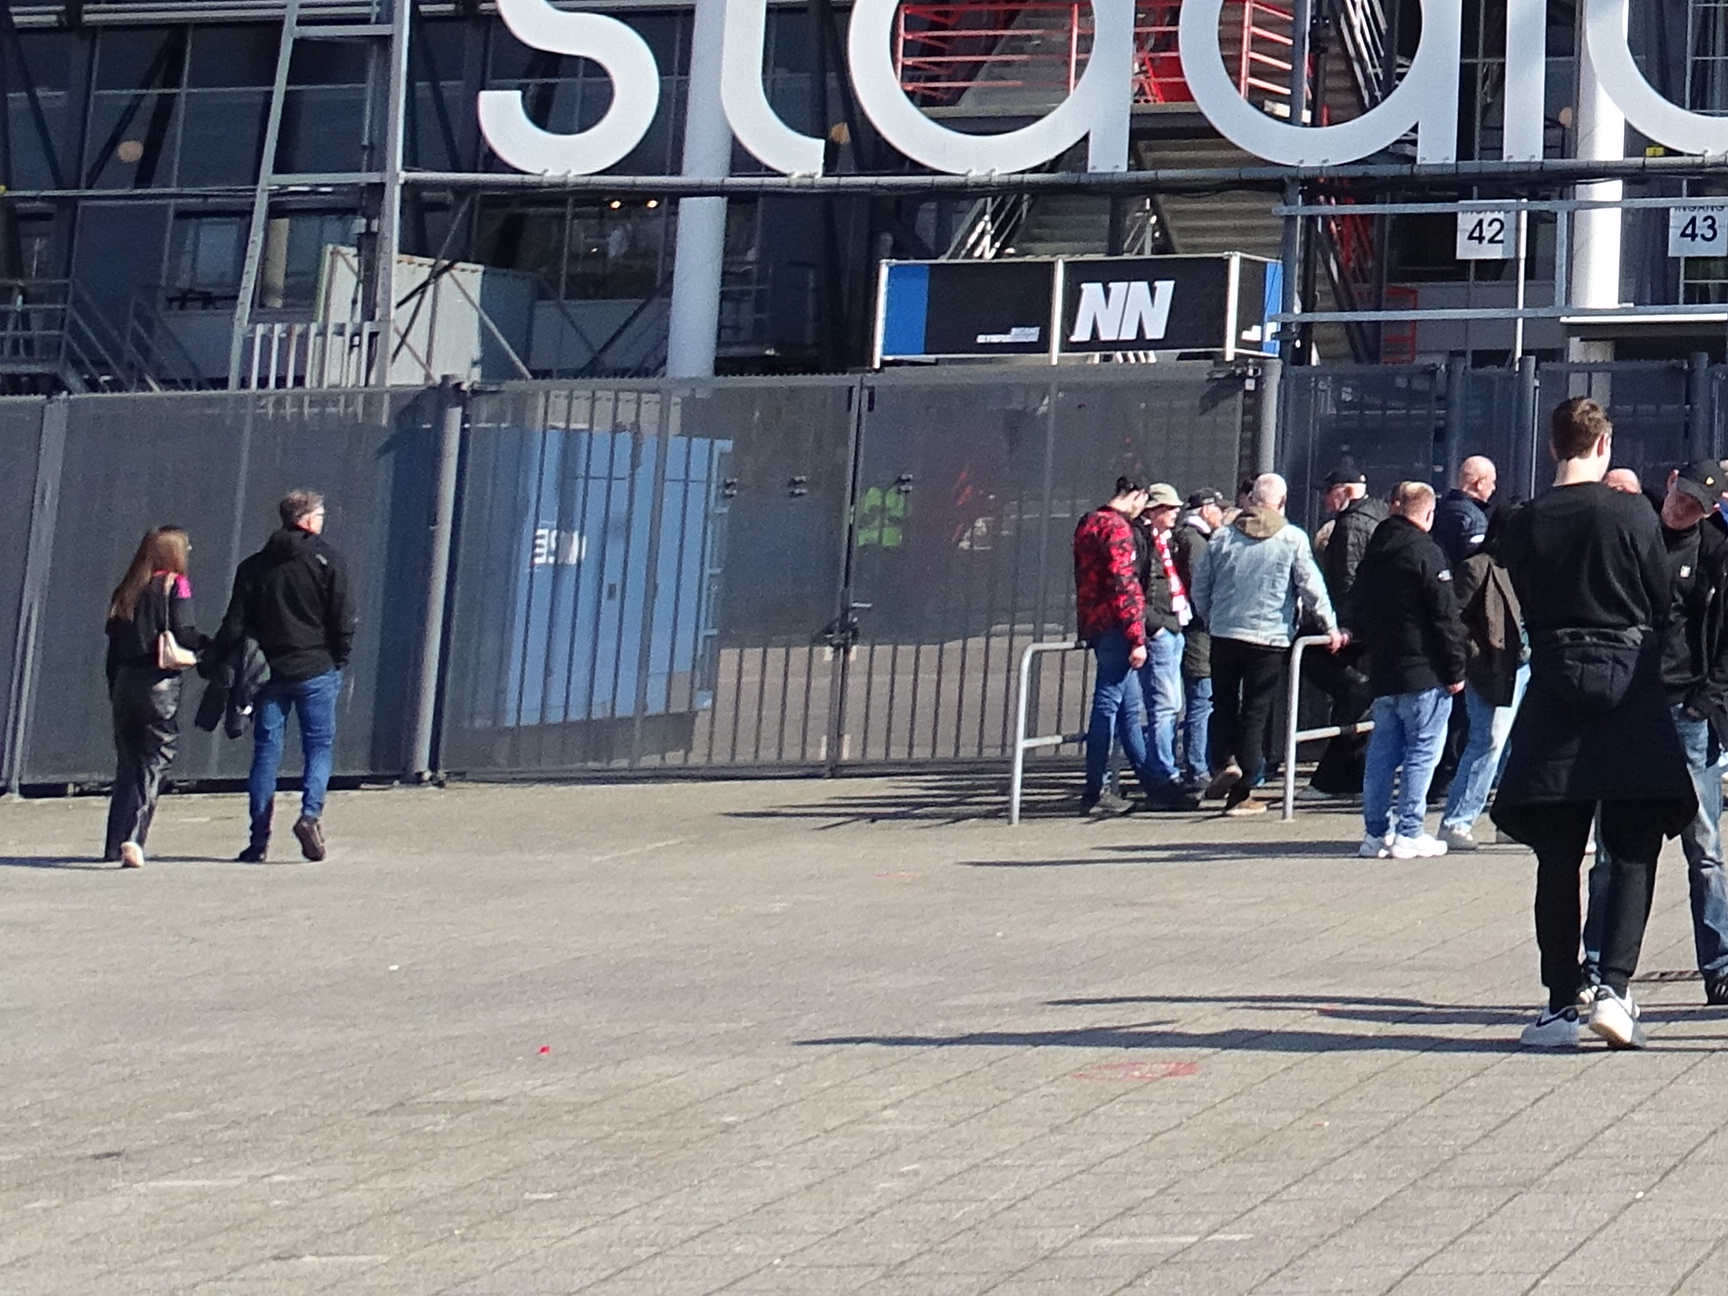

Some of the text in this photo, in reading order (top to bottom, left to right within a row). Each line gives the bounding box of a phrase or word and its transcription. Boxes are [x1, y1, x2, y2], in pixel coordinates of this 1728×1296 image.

[1467, 217, 1505, 245] 42
[1679, 214, 1718, 243] 43
[1069, 280, 1175, 342] NN
